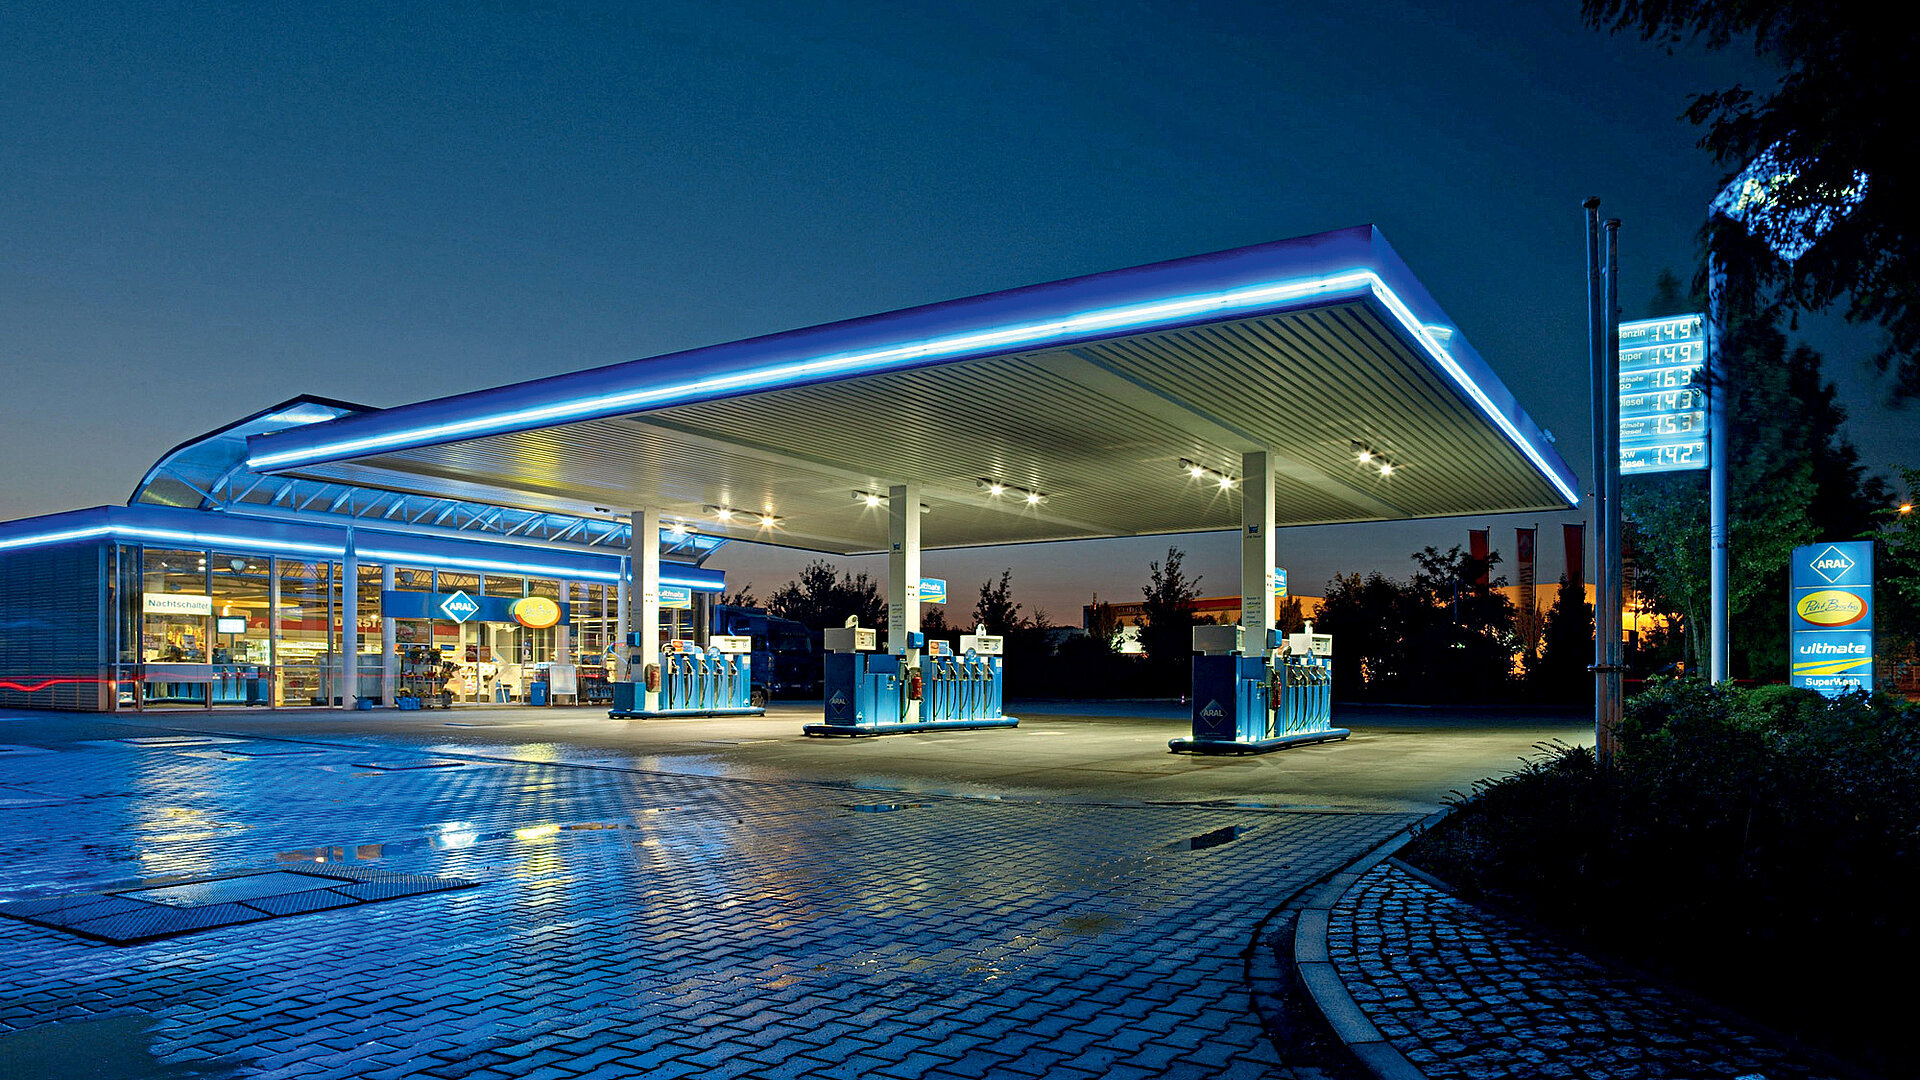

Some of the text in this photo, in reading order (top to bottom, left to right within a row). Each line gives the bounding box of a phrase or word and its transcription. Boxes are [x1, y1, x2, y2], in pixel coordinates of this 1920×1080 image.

[1817, 559, 1848, 569] ARAL
[148, 599, 208, 610] Nachtschalter
[449, 602, 474, 612] ARAL
[1800, 642, 1867, 654] ultimate
[1805, 677, 1861, 688] SuperWash
[1203, 709, 1224, 717] ARAL
